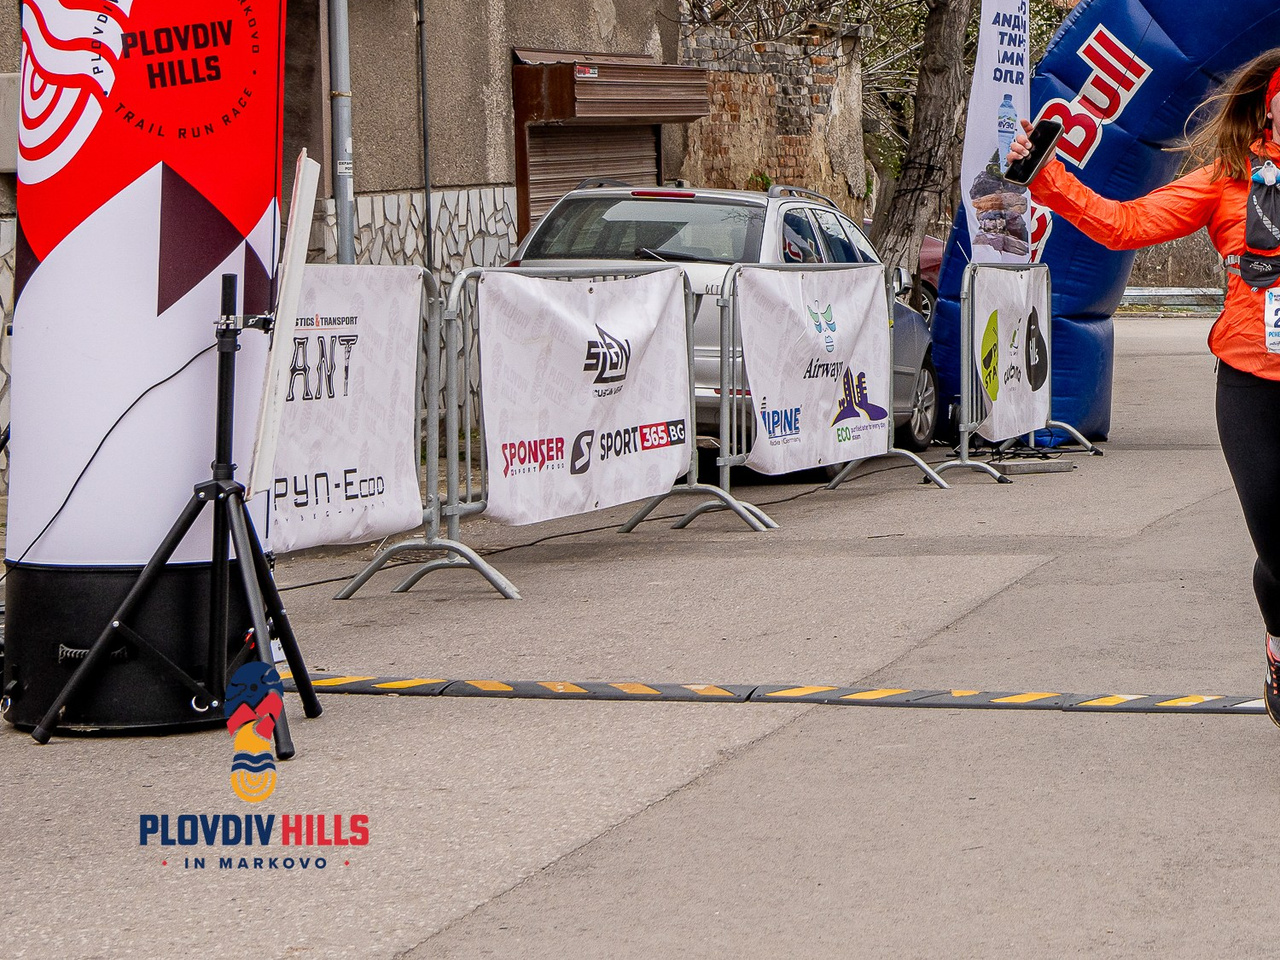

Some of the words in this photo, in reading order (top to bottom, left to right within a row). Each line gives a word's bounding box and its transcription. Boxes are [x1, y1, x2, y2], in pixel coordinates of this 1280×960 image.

[121, 19, 232, 59] PLOVDIV
[147, 55, 222, 89] HILLS
[114, 102, 165, 137] TRAIL
[178, 123, 214, 139] RUN
[221, 87, 252, 125] RACE
[320, 316, 358, 326] TRANSPORT
[836, 427, 851, 442] ECO
[502, 437, 564, 478] SPONSER
